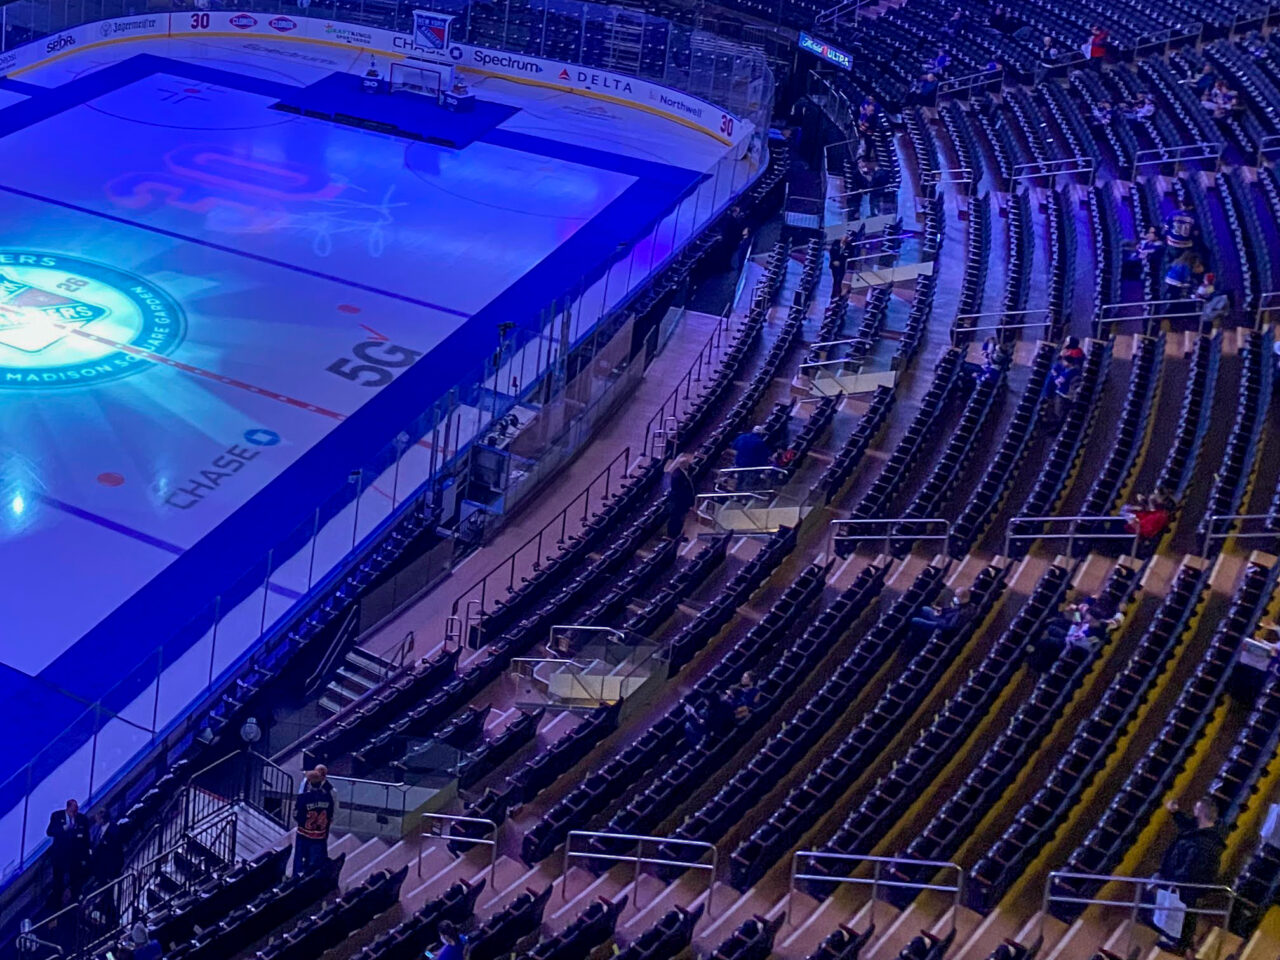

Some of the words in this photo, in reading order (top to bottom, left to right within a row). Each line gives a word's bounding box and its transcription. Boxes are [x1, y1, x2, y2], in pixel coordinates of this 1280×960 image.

[190, 13, 210, 29] 30
[473, 49, 539, 74] Spectrum
[577, 71, 633, 94] DELTA
[659, 93, 702, 119] Northwell
[720, 114, 734, 137] 30
[56, 277, 90, 293] 26
[6, 364, 112, 383] MADISON
[130, 286, 171, 325] GARDEN
[324, 340, 424, 388] 5G
[164, 444, 261, 511] CHASE
